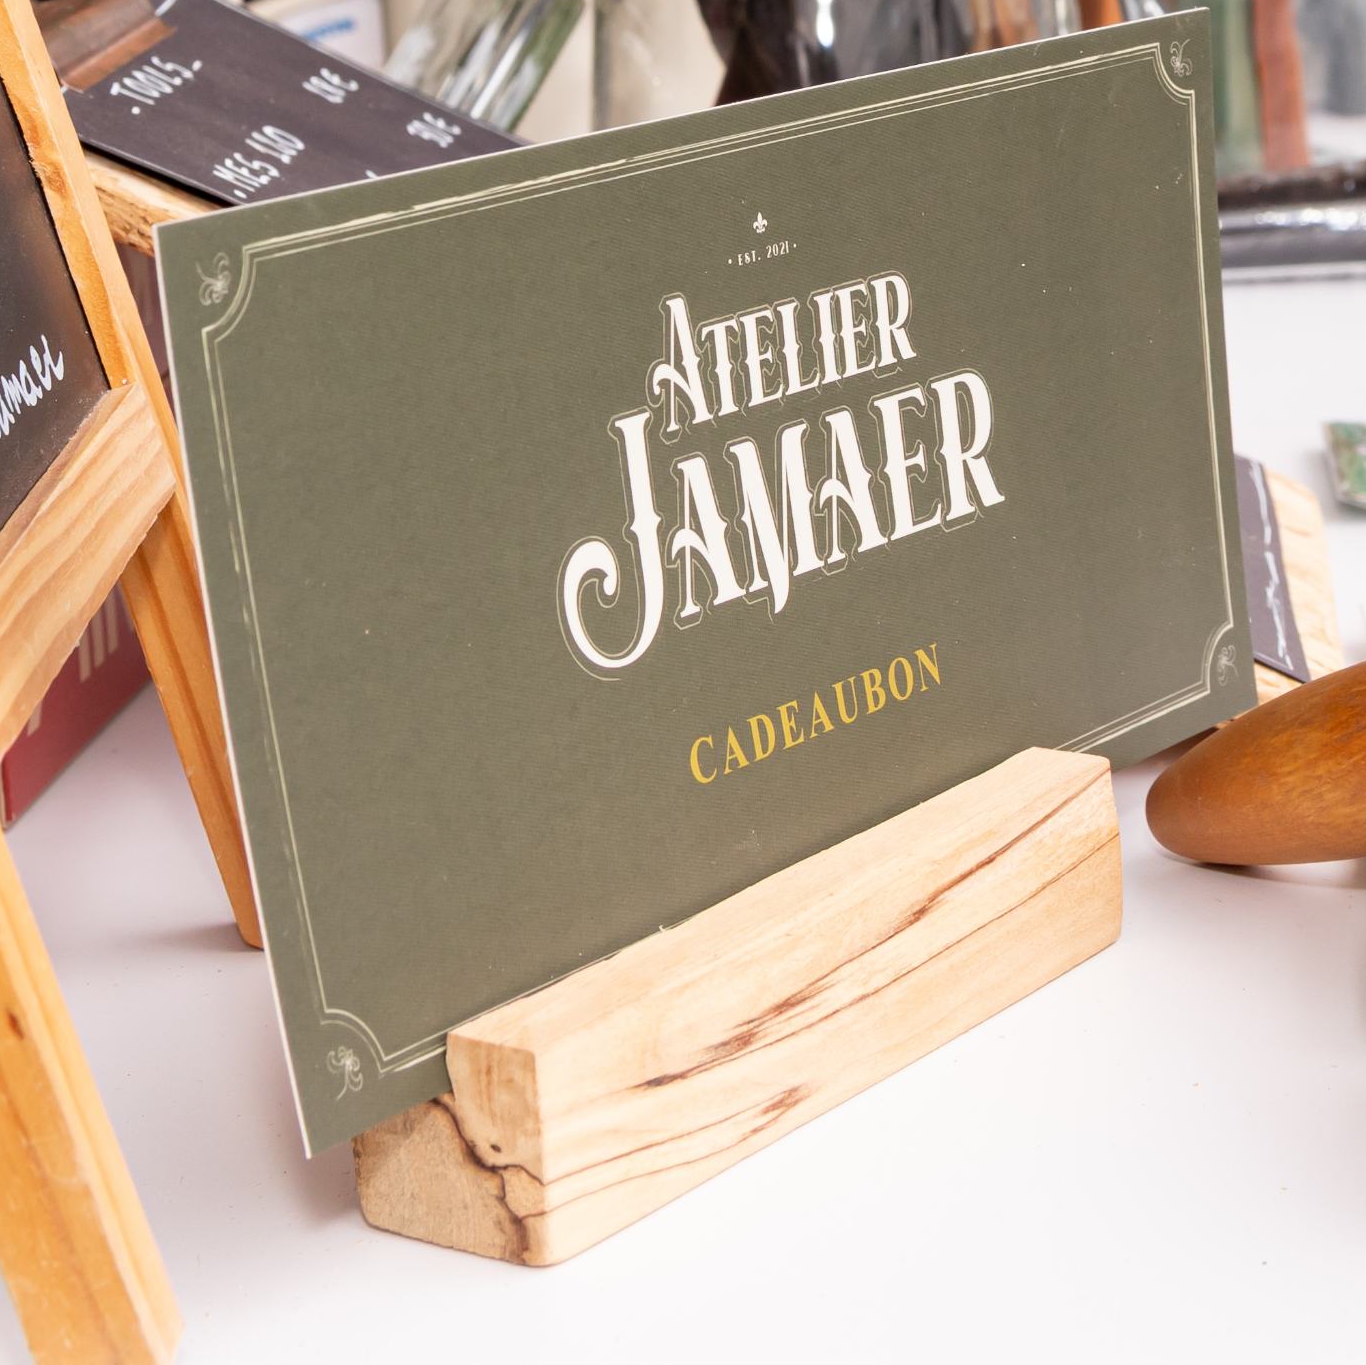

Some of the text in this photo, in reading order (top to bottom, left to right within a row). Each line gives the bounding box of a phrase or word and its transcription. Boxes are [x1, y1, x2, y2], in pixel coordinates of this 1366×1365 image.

[737, 240, 790, 267] EST. 2021
[651, 271, 918, 434] ATELIER
[561, 371, 1006, 669] JAMAER
[690, 643, 942, 784] CADEAUBON
